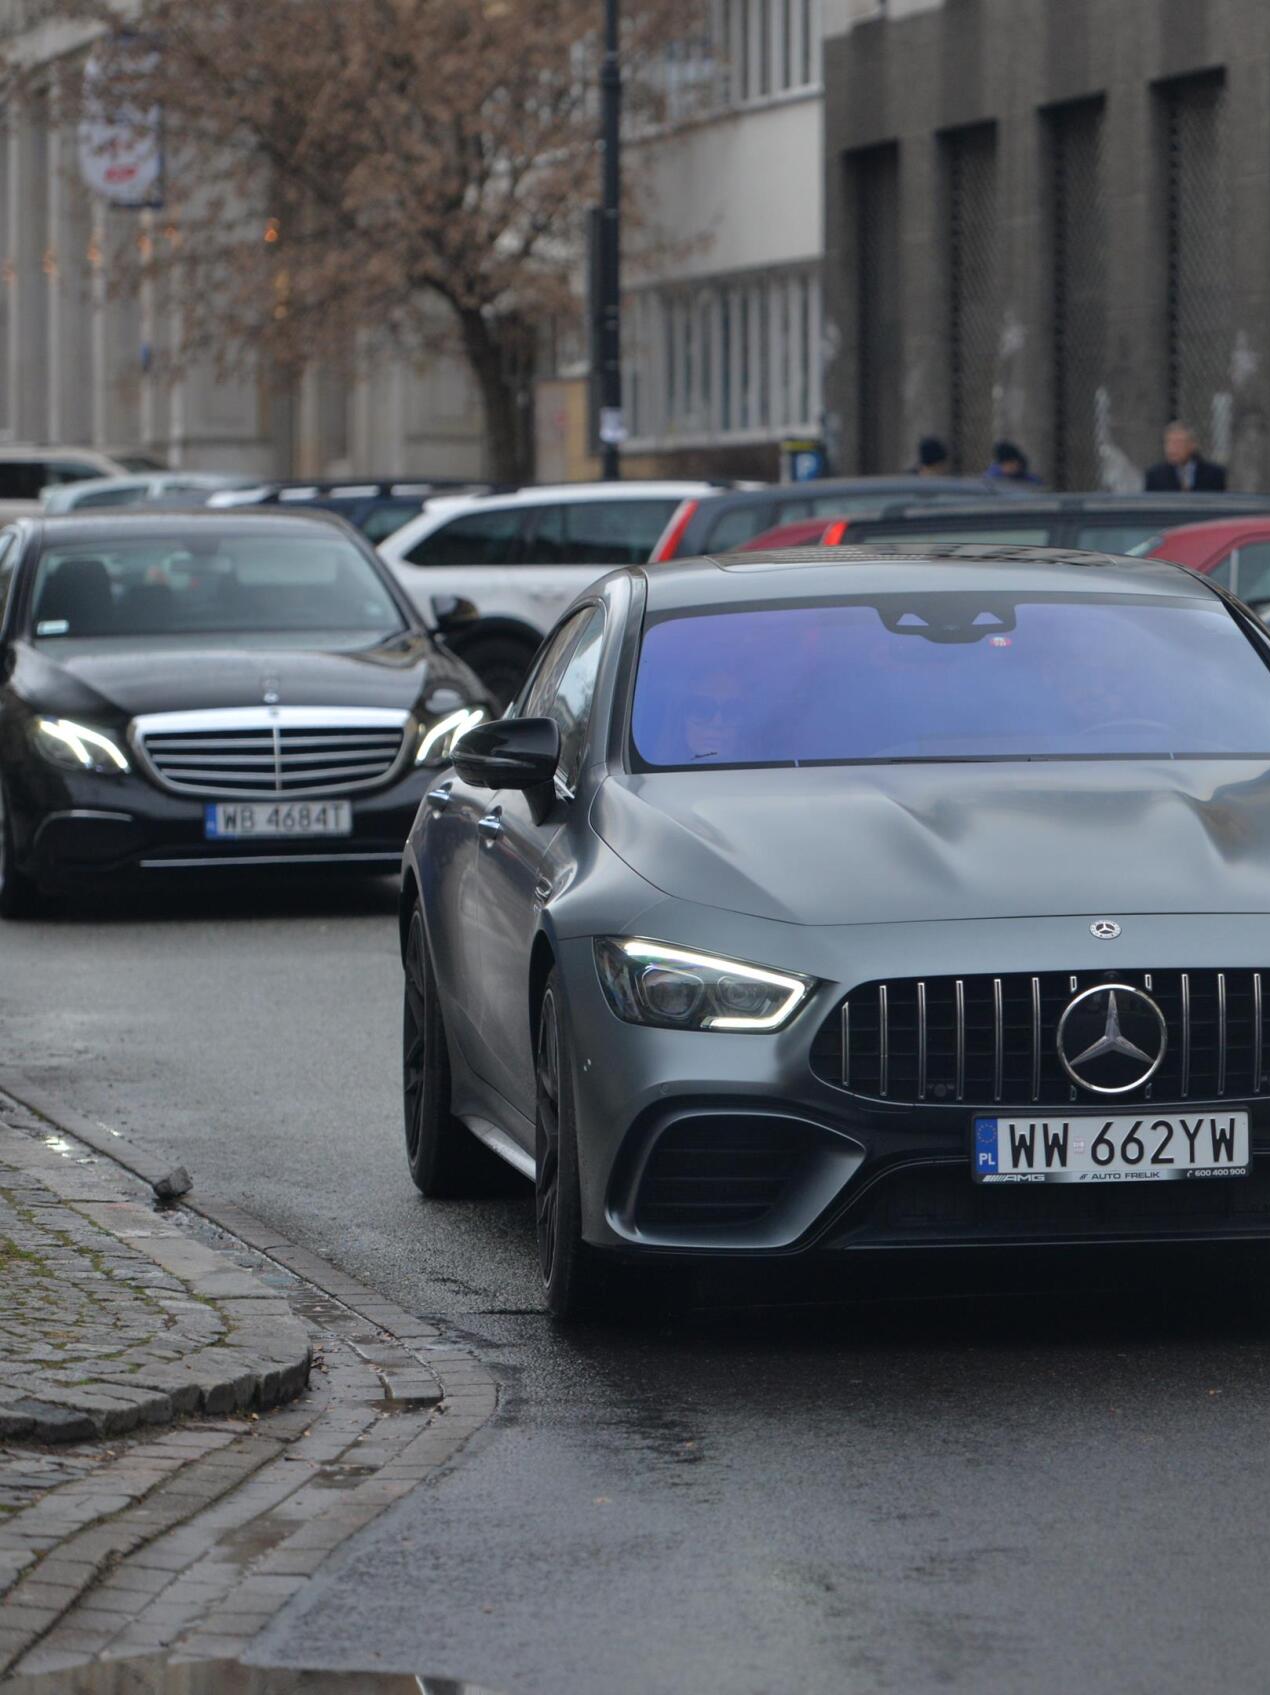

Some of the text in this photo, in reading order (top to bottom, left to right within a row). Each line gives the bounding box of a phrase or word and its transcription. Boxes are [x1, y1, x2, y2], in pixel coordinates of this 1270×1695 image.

[222, 805, 255, 830] WB
[266, 803, 343, 831] 4684T
[1009, 1118, 1236, 1168] WW 662YW
[979, 1153, 996, 1166] PL
[1003, 1174, 1046, 1182] AMG
[1125, 1171, 1160, 1179] FRELIK
[1195, 1169, 1211, 1177] 600
[1230, 1168, 1246, 1176] 900
